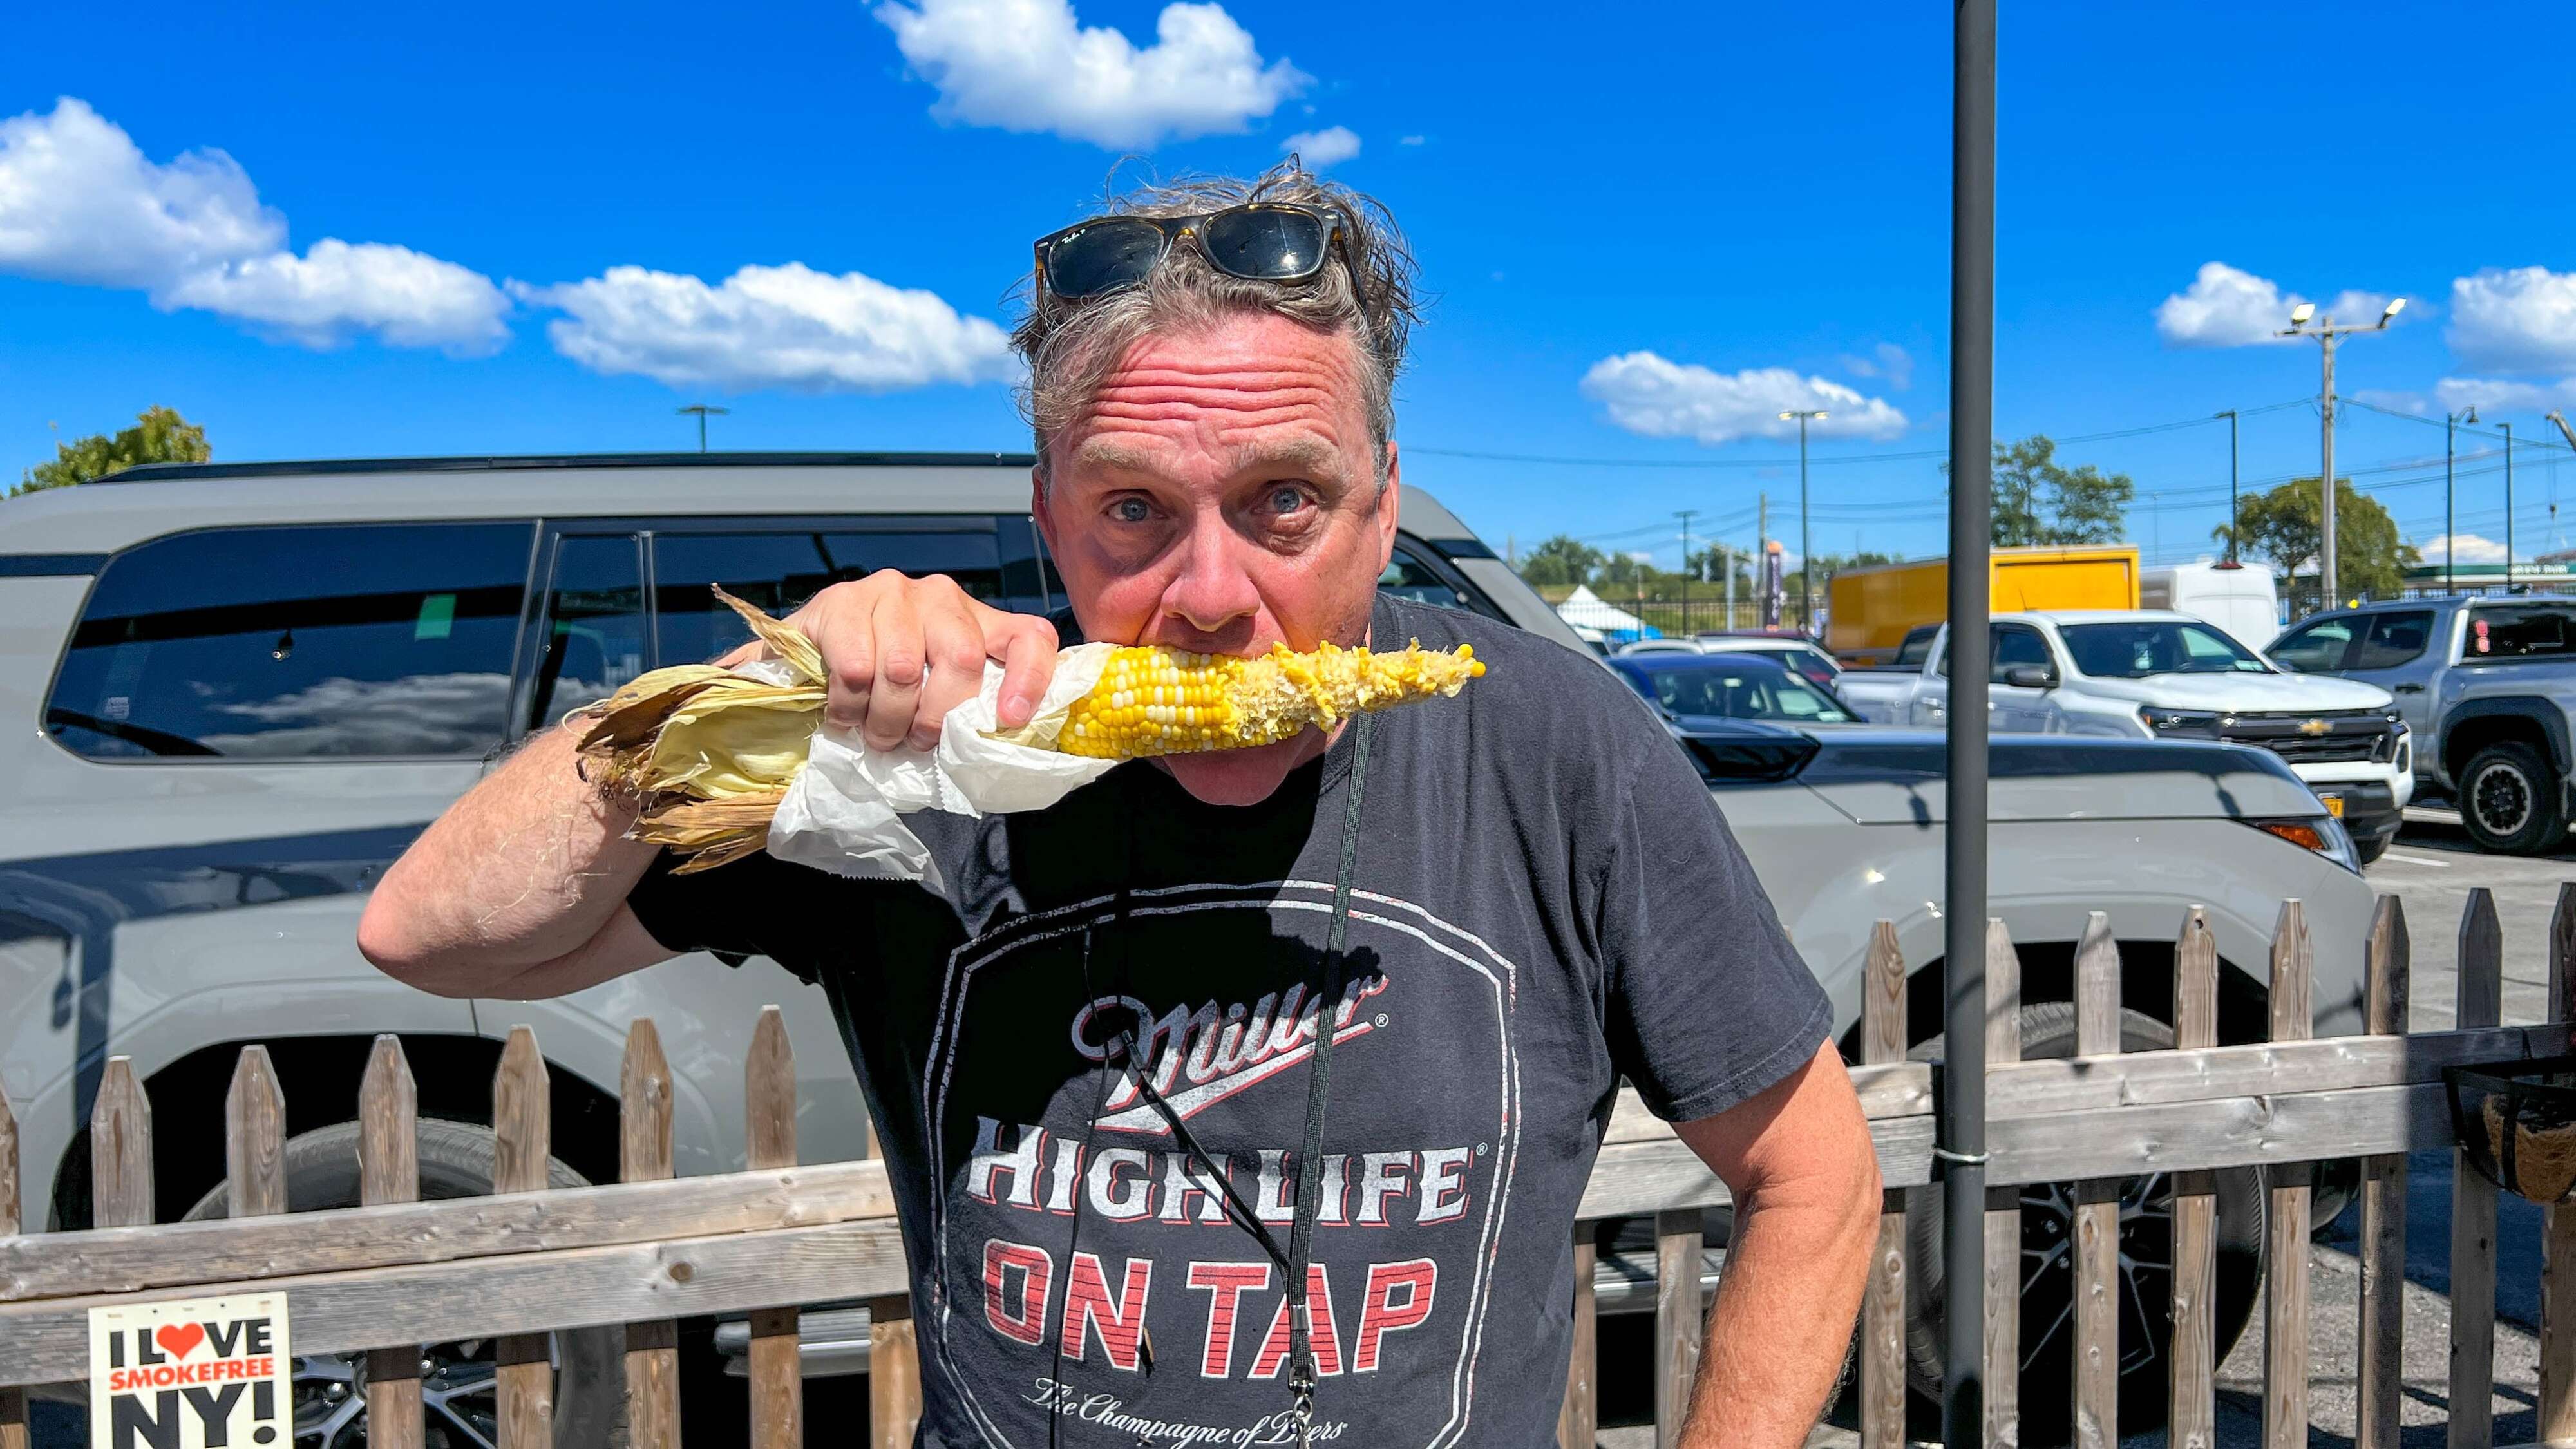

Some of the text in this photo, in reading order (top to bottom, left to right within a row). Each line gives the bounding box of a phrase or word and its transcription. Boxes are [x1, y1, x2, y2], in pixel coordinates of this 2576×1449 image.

[965, 1115, 1233, 1227] HIGH
[1254, 1145, 1474, 1227] LIFE
[982, 1238, 1438, 1380] ON TAP
[109, 1329, 125, 1369] I
[109, 1356, 276, 1392] SMOKEFREE
[110, 1380, 277, 1449] NY!
[1078, 1392, 1228, 1449] Champagne
[1231, 1414, 1271, 1449] of
[1254, 1409, 1346, 1444] Bers
